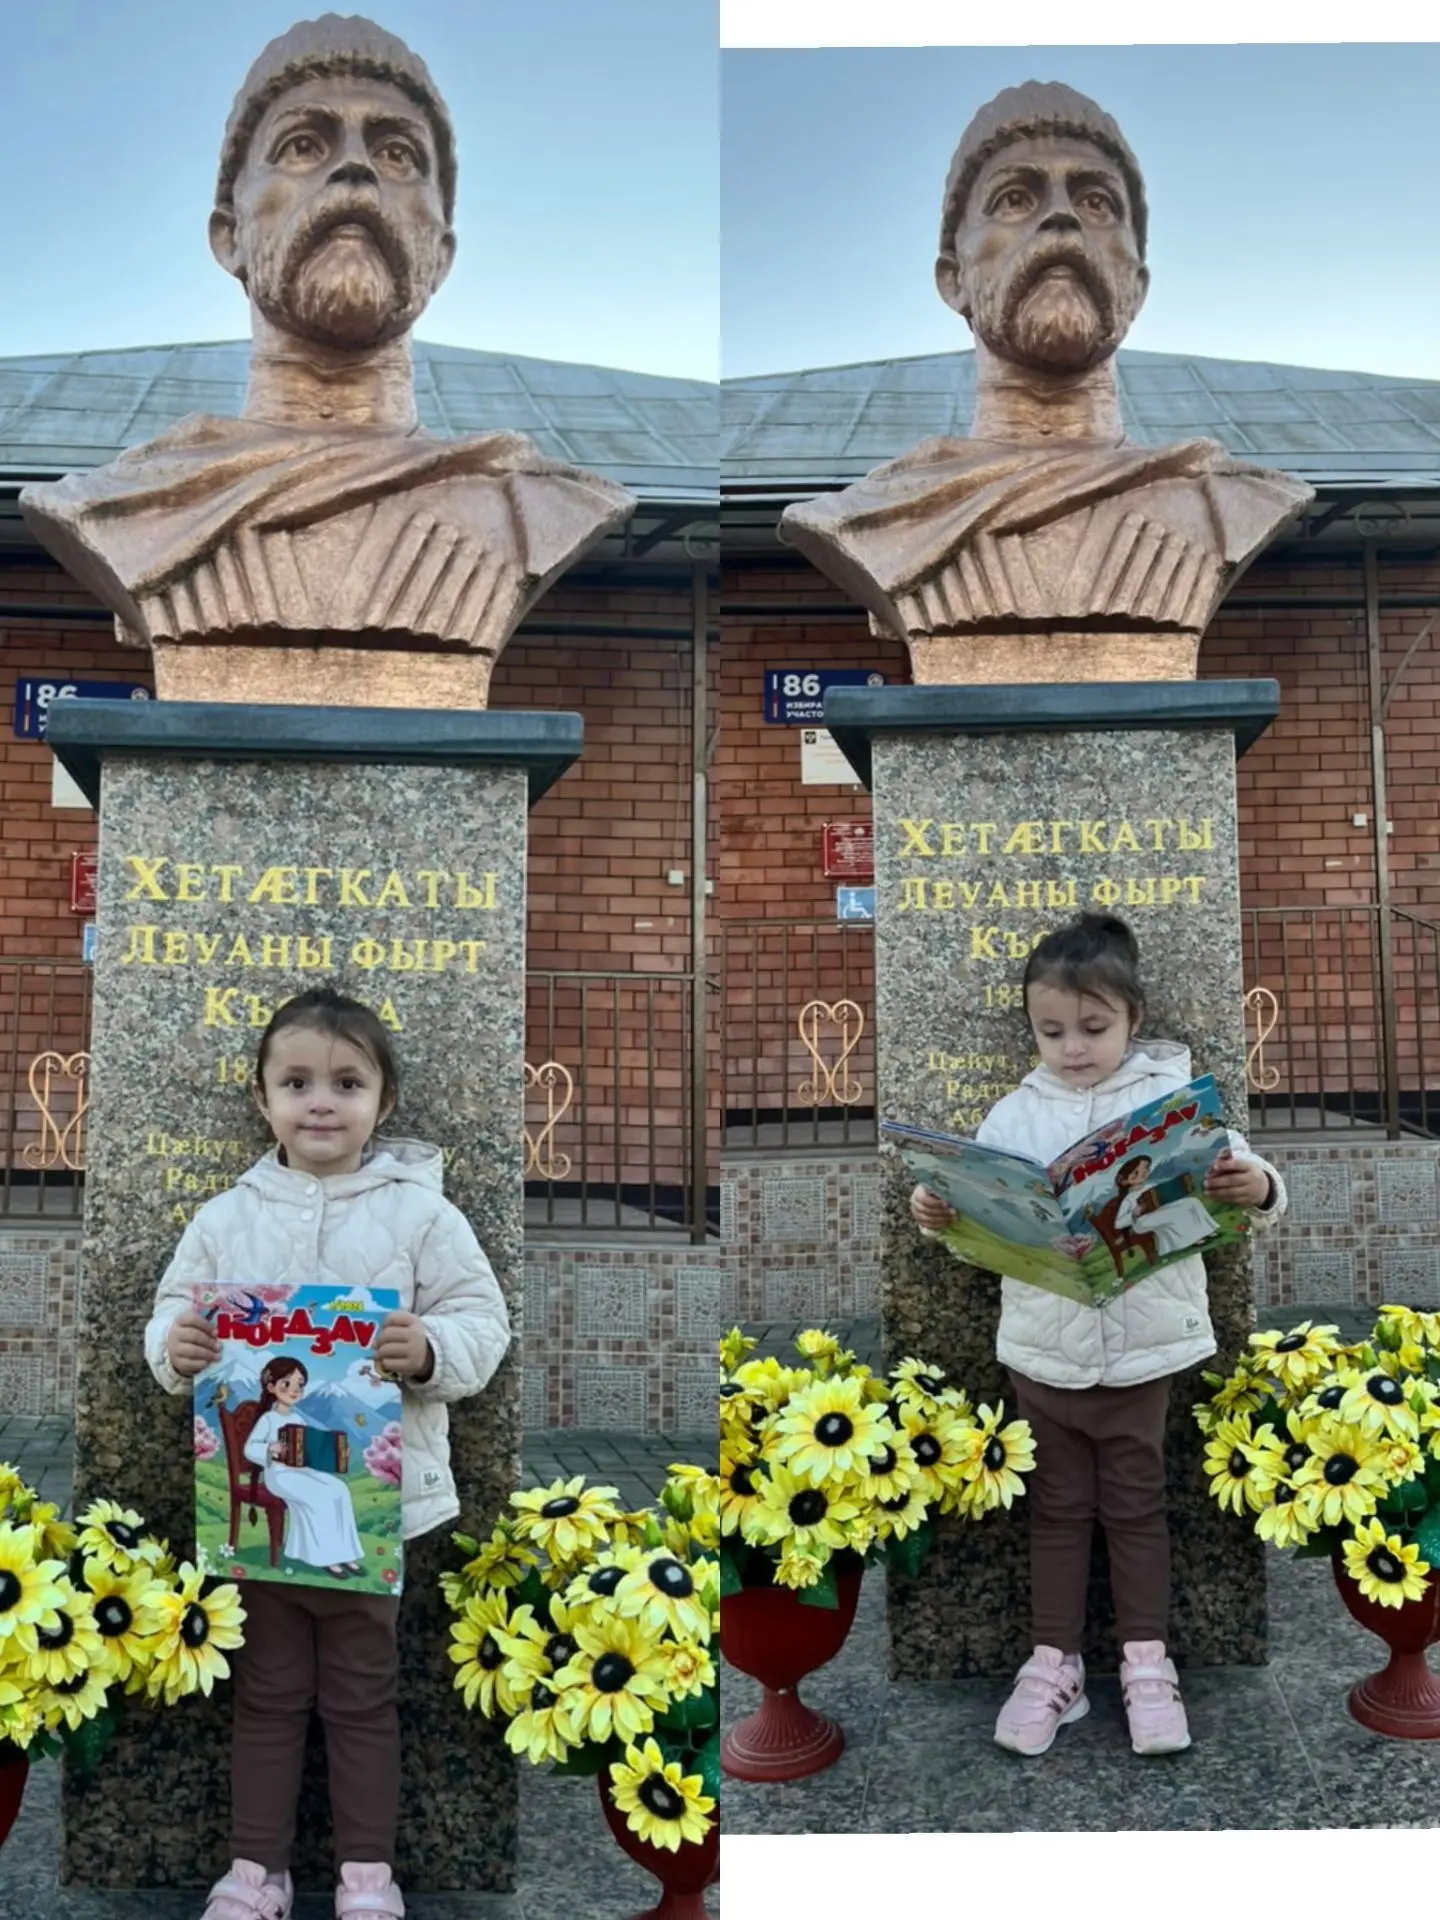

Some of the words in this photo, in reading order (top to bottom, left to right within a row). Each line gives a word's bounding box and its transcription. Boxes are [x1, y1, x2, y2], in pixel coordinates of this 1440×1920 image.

[782, 673, 821, 697] 86
[897, 876, 1077, 910] ЛЕУАНЫ
[1092, 875, 1207, 906] ФЫРТ
[120, 924, 334, 970] ЛЕУАНЫ
[350, 937, 488, 974] ФЫРТ
